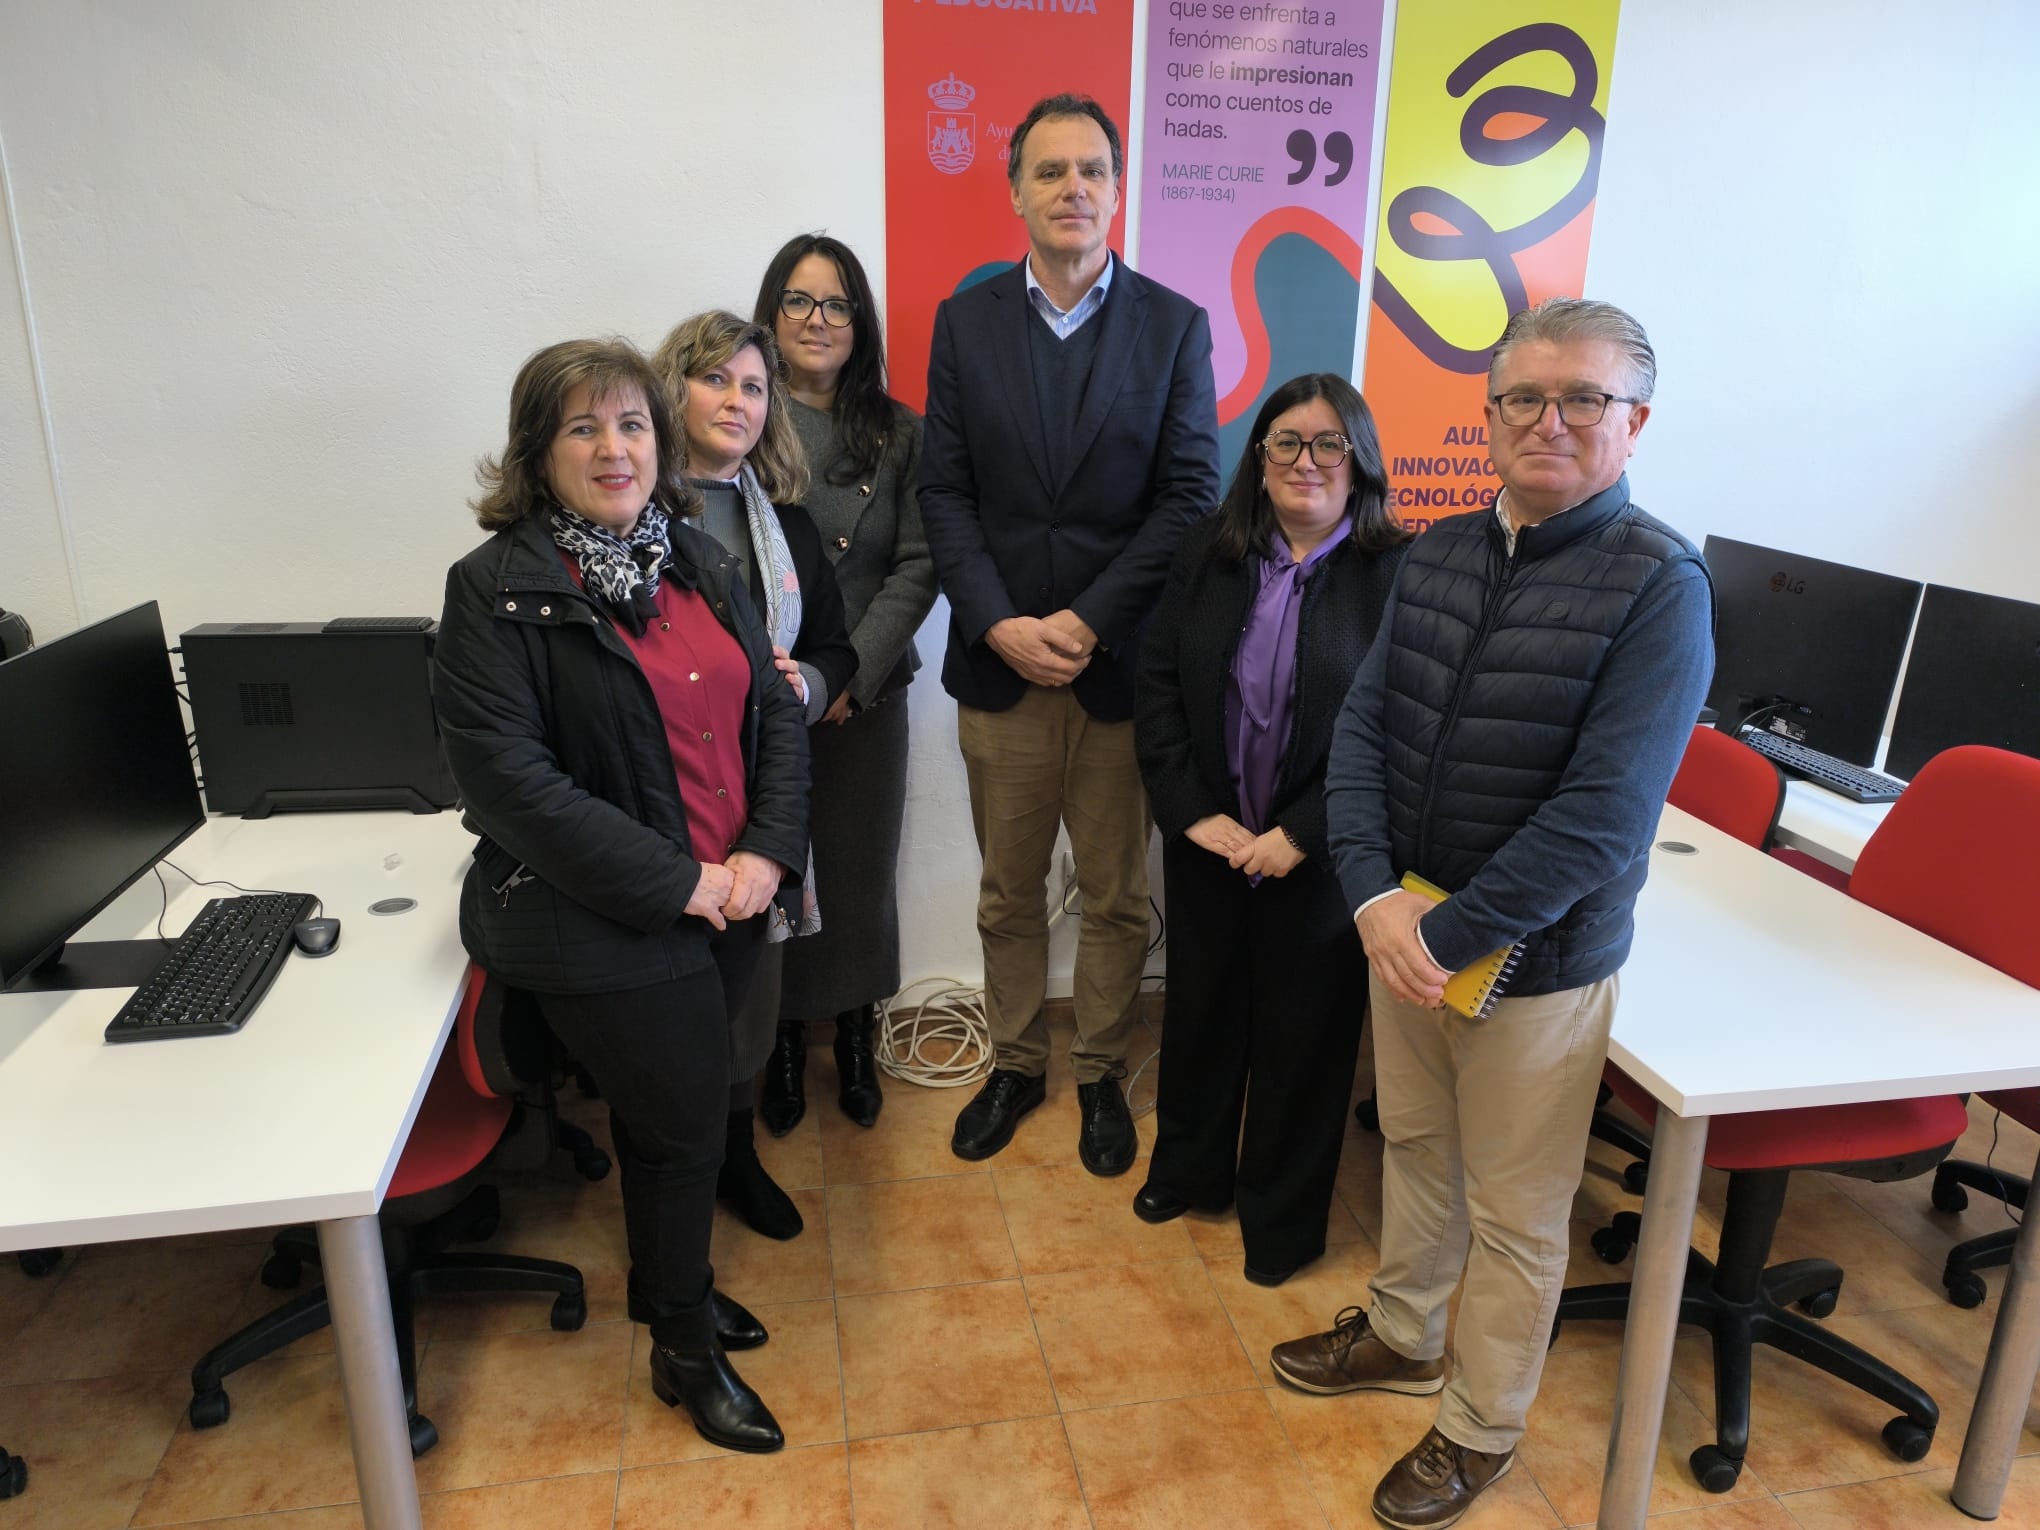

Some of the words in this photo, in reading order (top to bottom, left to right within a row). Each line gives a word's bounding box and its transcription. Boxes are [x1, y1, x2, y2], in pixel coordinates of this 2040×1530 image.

[1169, 1, 1207, 21] que
[1212, 3, 1234, 20] se
[1239, 3, 1319, 26] enfrenta
[1324, 11, 1336, 26] a
[1168, 27, 1277, 53] fenómenos
[1282, 36, 1369, 58] naturales
[1167, 61, 1204, 82] que
[1209, 60, 1225, 80] le
[1230, 61, 1353, 87] impresionan
[1165, 92, 1221, 110] como
[1226, 95, 1304, 114] cuentos
[1308, 97, 1333, 115] de
[985, 122, 1014, 140] Ayu
[1164, 117, 1228, 140] hadas.
[1162, 163, 1213, 181] MARIE
[1217, 165, 1265, 183] CURIE
[1161, 186, 1235, 204] (1867-1934)
[1442, 426, 1488, 446] AUL
[1392, 457, 1497, 477] INNOVAC
[1386, 483, 1500, 507] ECNOLÓG
[1786, 575, 1806, 595] LG
